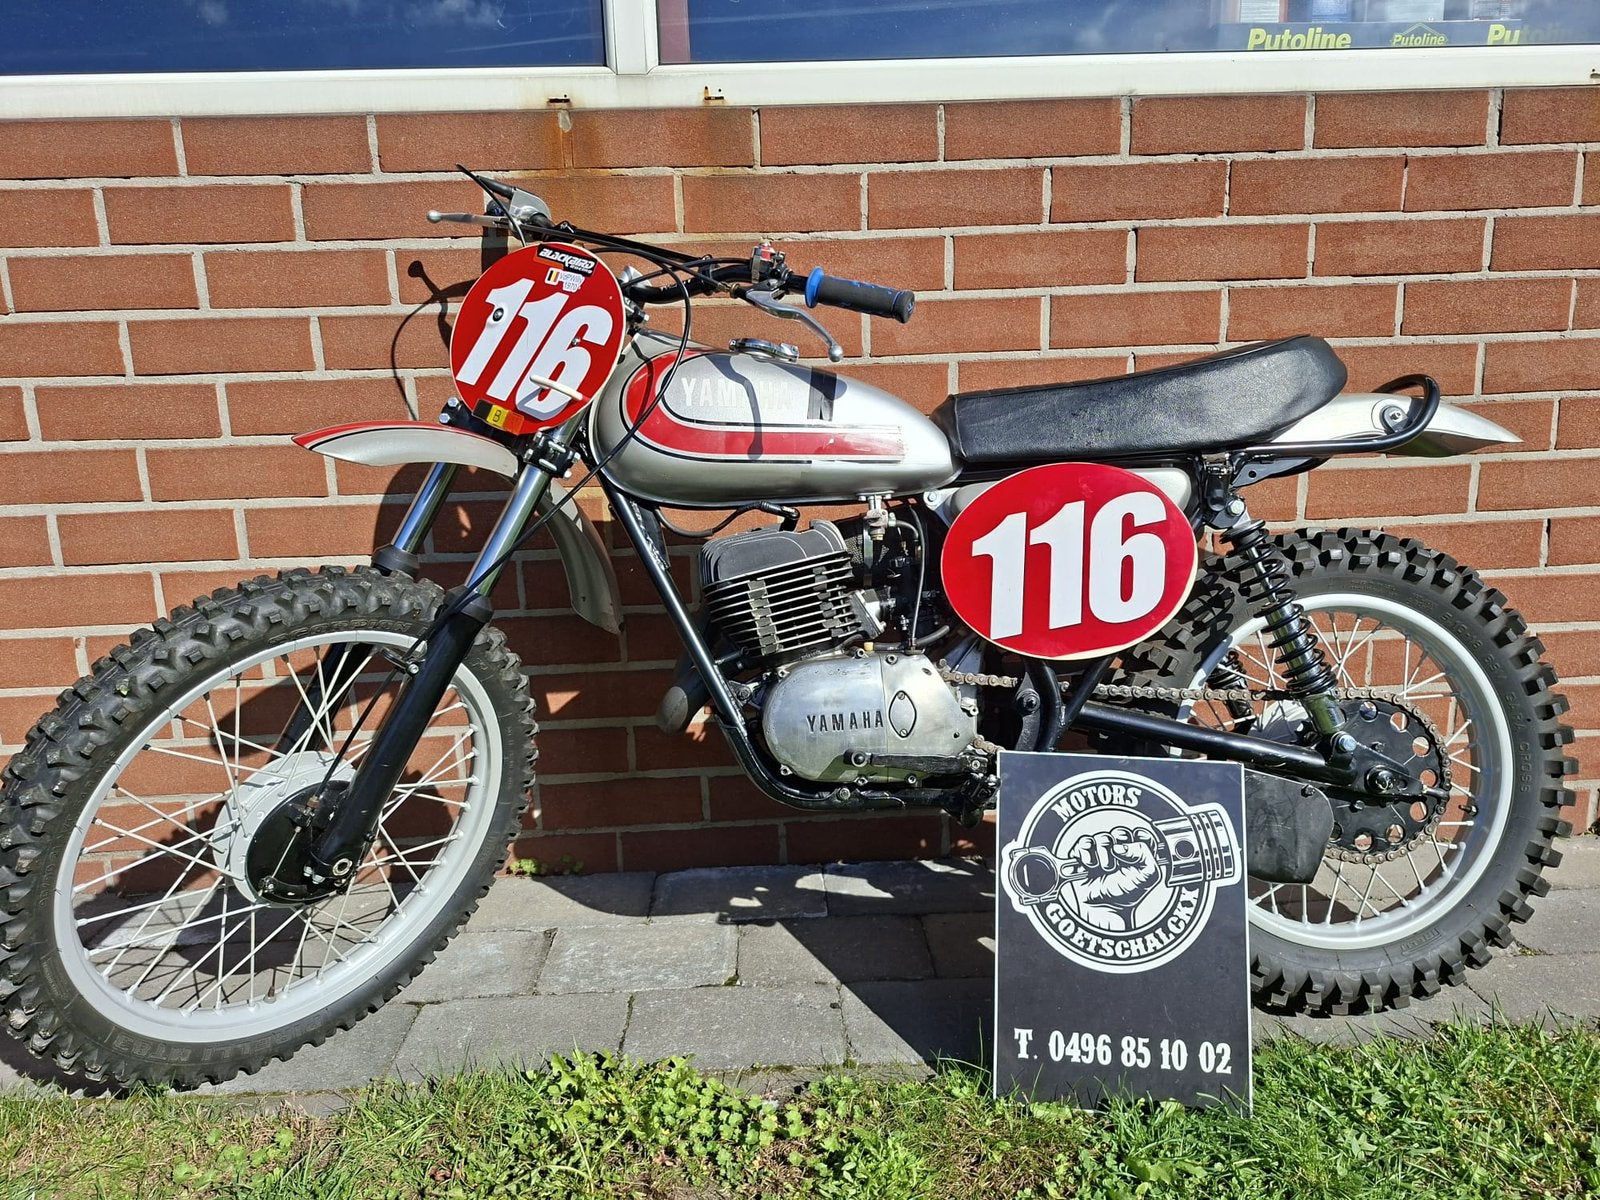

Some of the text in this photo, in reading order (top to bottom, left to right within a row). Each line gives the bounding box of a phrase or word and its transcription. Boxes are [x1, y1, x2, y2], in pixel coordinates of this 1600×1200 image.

[1248, 28, 1351, 50] Putoline
[1392, 33, 1446, 46] Putoline
[539, 248, 595, 269] BLACKBIRD
[456, 278, 613, 421] 116
[493, 410, 501, 422] B
[971, 491, 1167, 640] 116
[806, 710, 884, 733] YAMAHA
[1519, 742, 1533, 793] CROSS
[1051, 784, 1142, 822] MOTORS
[1046, 887, 1200, 958] GOETSCHALCKX
[1014, 1028, 1232, 1075] T. 0496 85 10 02
